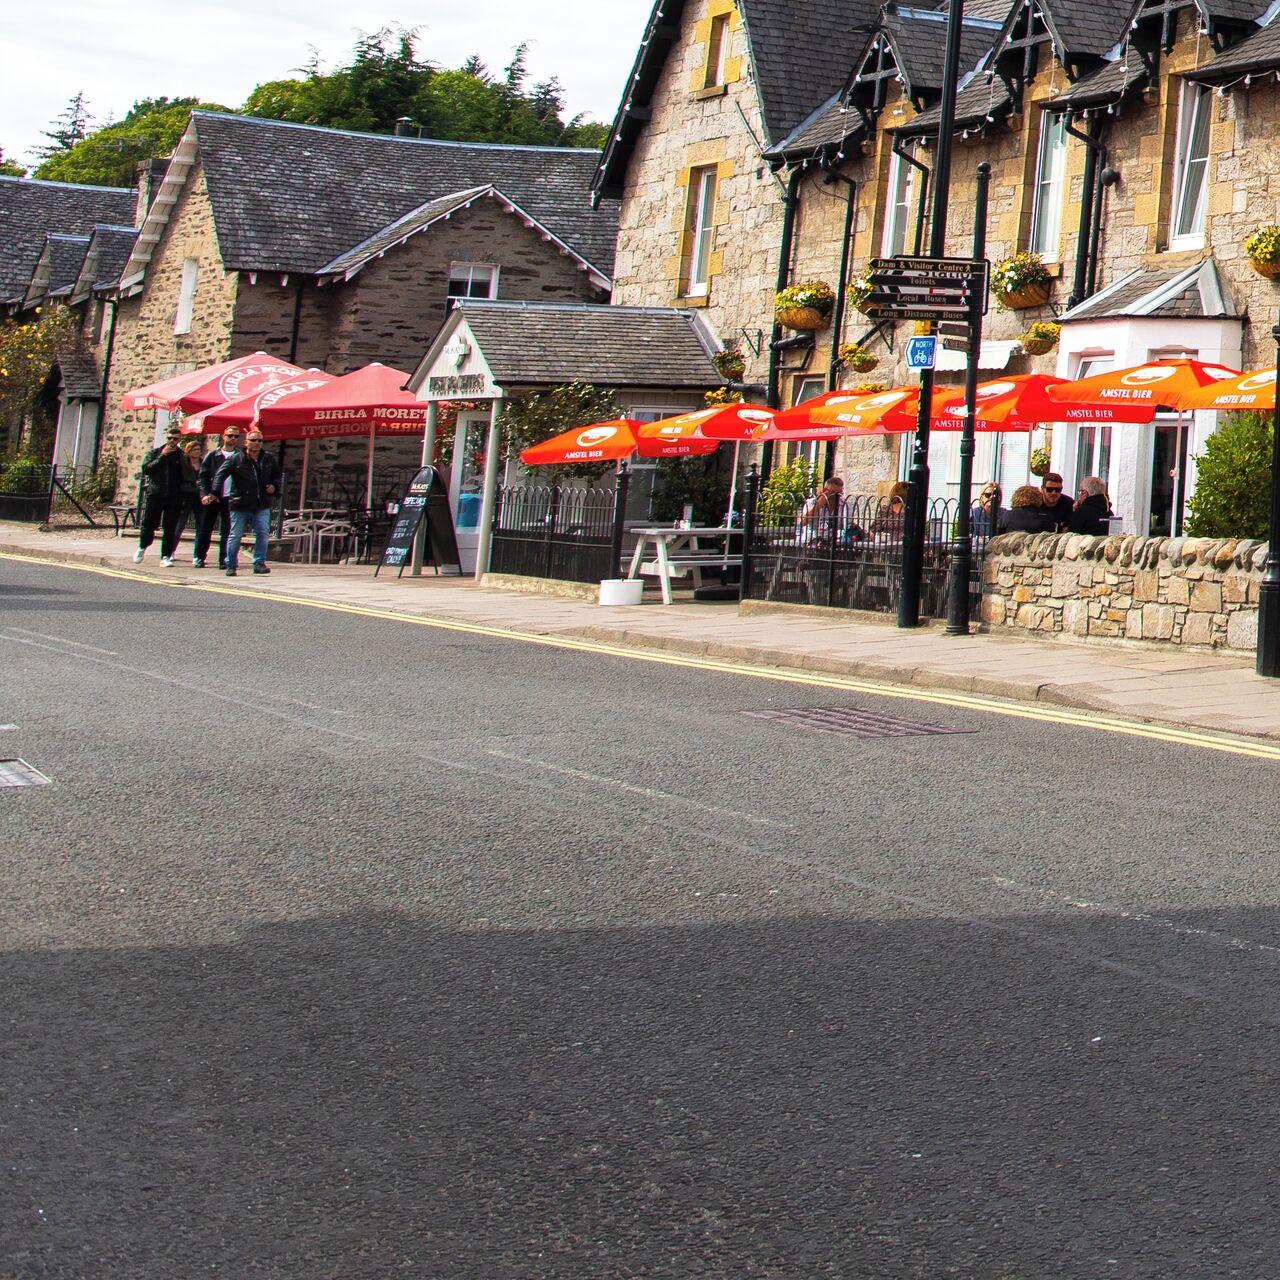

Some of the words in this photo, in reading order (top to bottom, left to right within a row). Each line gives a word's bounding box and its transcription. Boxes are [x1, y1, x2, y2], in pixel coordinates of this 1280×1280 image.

[900, 261, 906, 269] &
[908, 261, 934, 270] Visitor
[938, 263, 964, 272] Centre
[910, 277, 936, 285] Toilets
[878, 310, 898, 318] Long
[904, 310, 937, 319] Distance
[942, 311, 964, 319] Buses
[260, 385, 305, 409] IRRA
[1100, 388, 1131, 399] AMSTEL
[1132, 389, 1152, 399] BIER
[314, 409, 367, 420] BIRRA
[373, 407, 429, 419] MORET
[1066, 409, 1094, 419] AMSTEL
[1095, 409, 1113, 419] BIER
